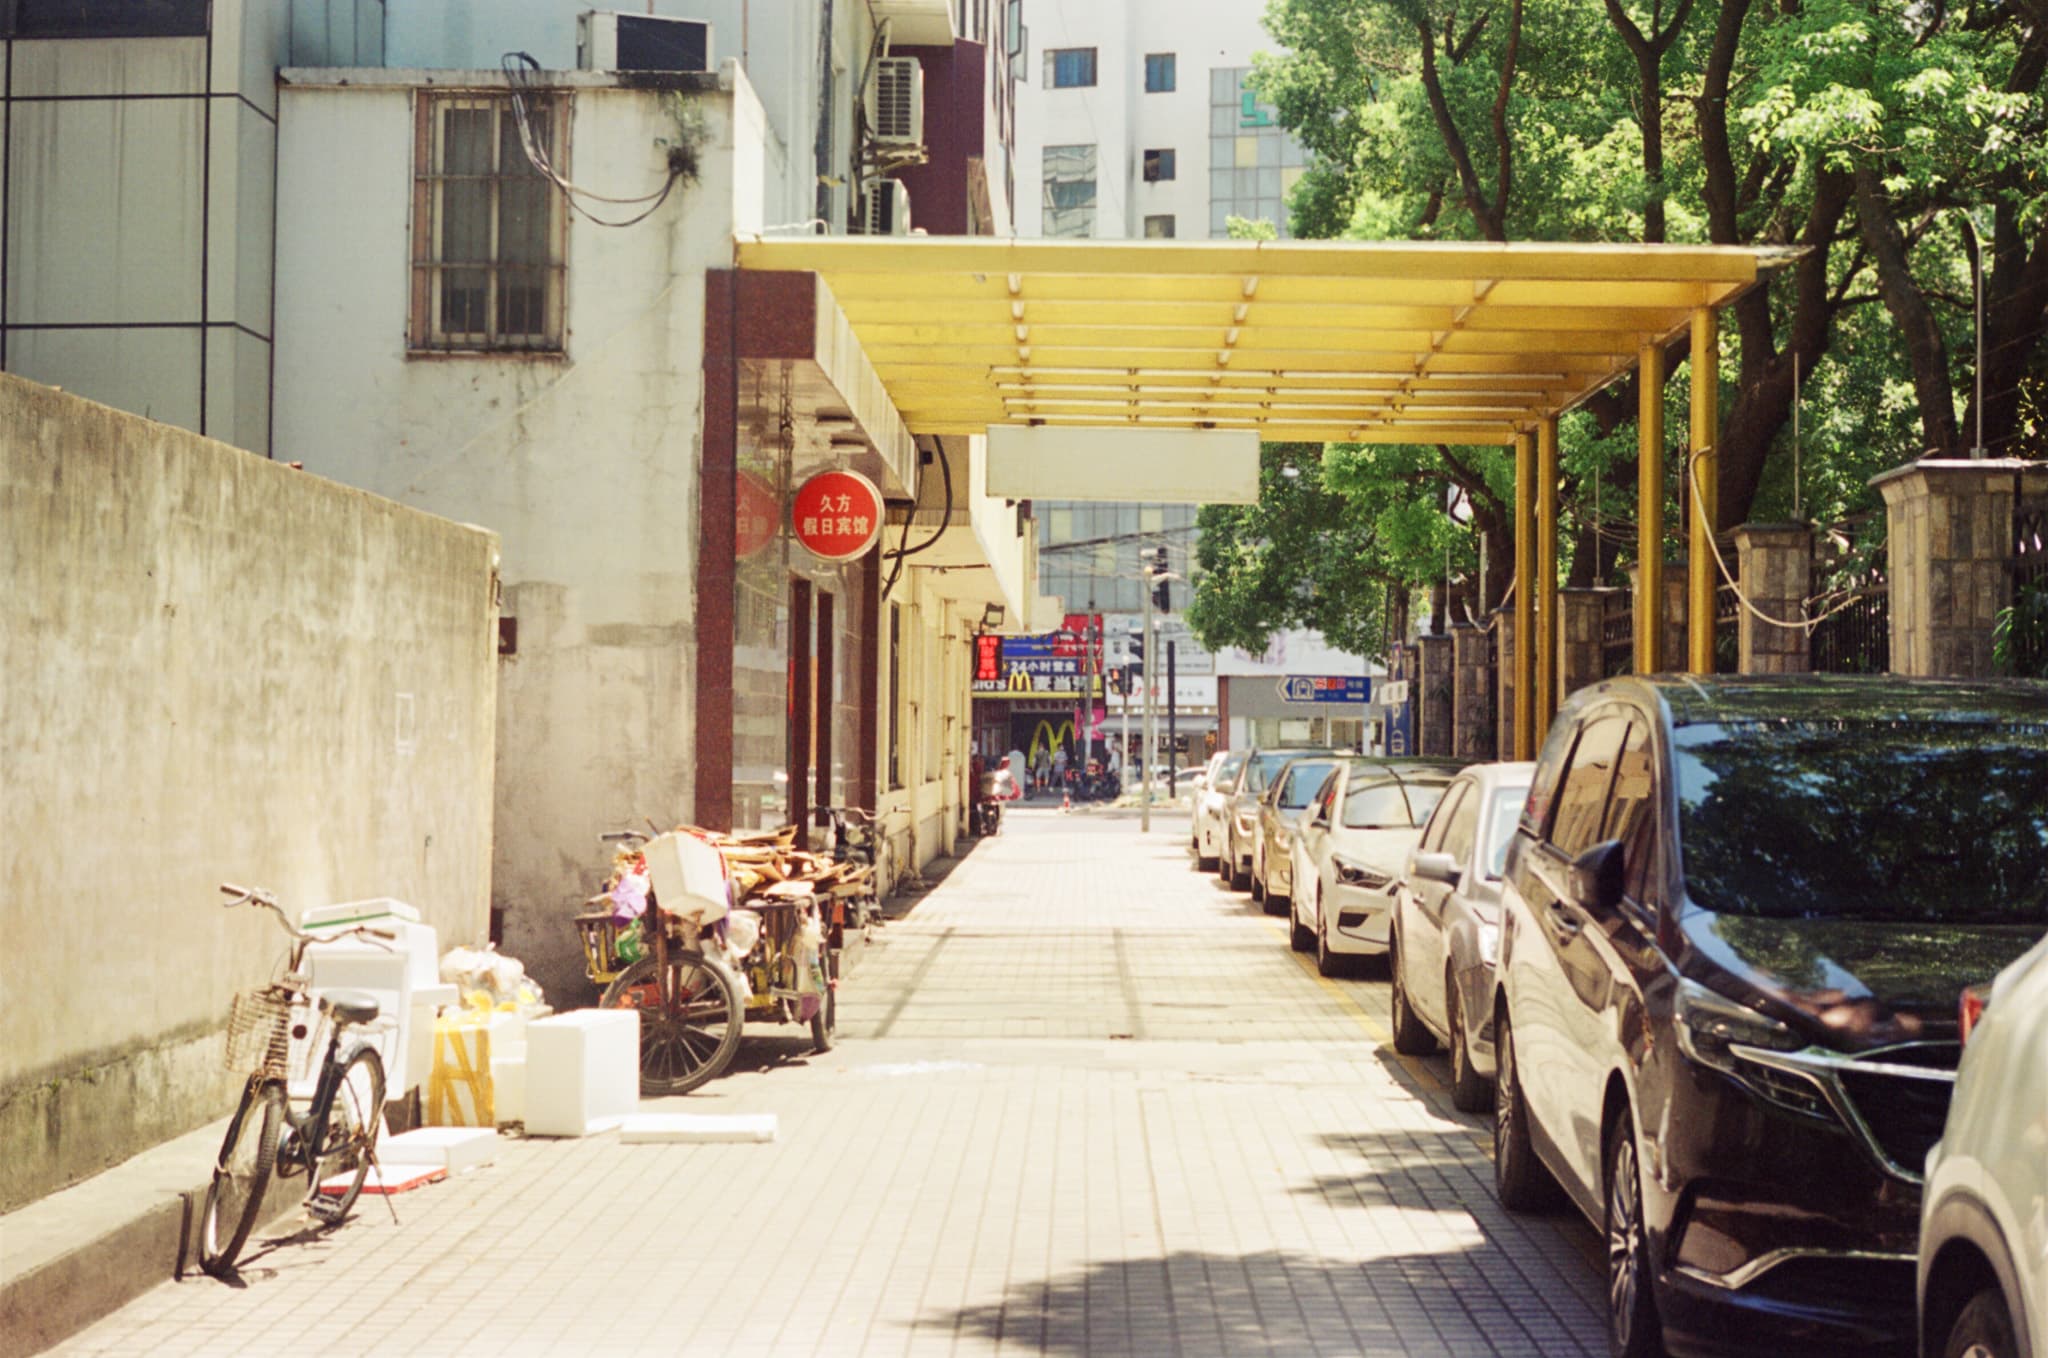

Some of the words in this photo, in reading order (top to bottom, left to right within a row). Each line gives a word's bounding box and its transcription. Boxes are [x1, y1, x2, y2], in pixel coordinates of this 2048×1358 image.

[820, 494, 852, 513] 久方
[803, 516, 869, 536] 假日宾馆
